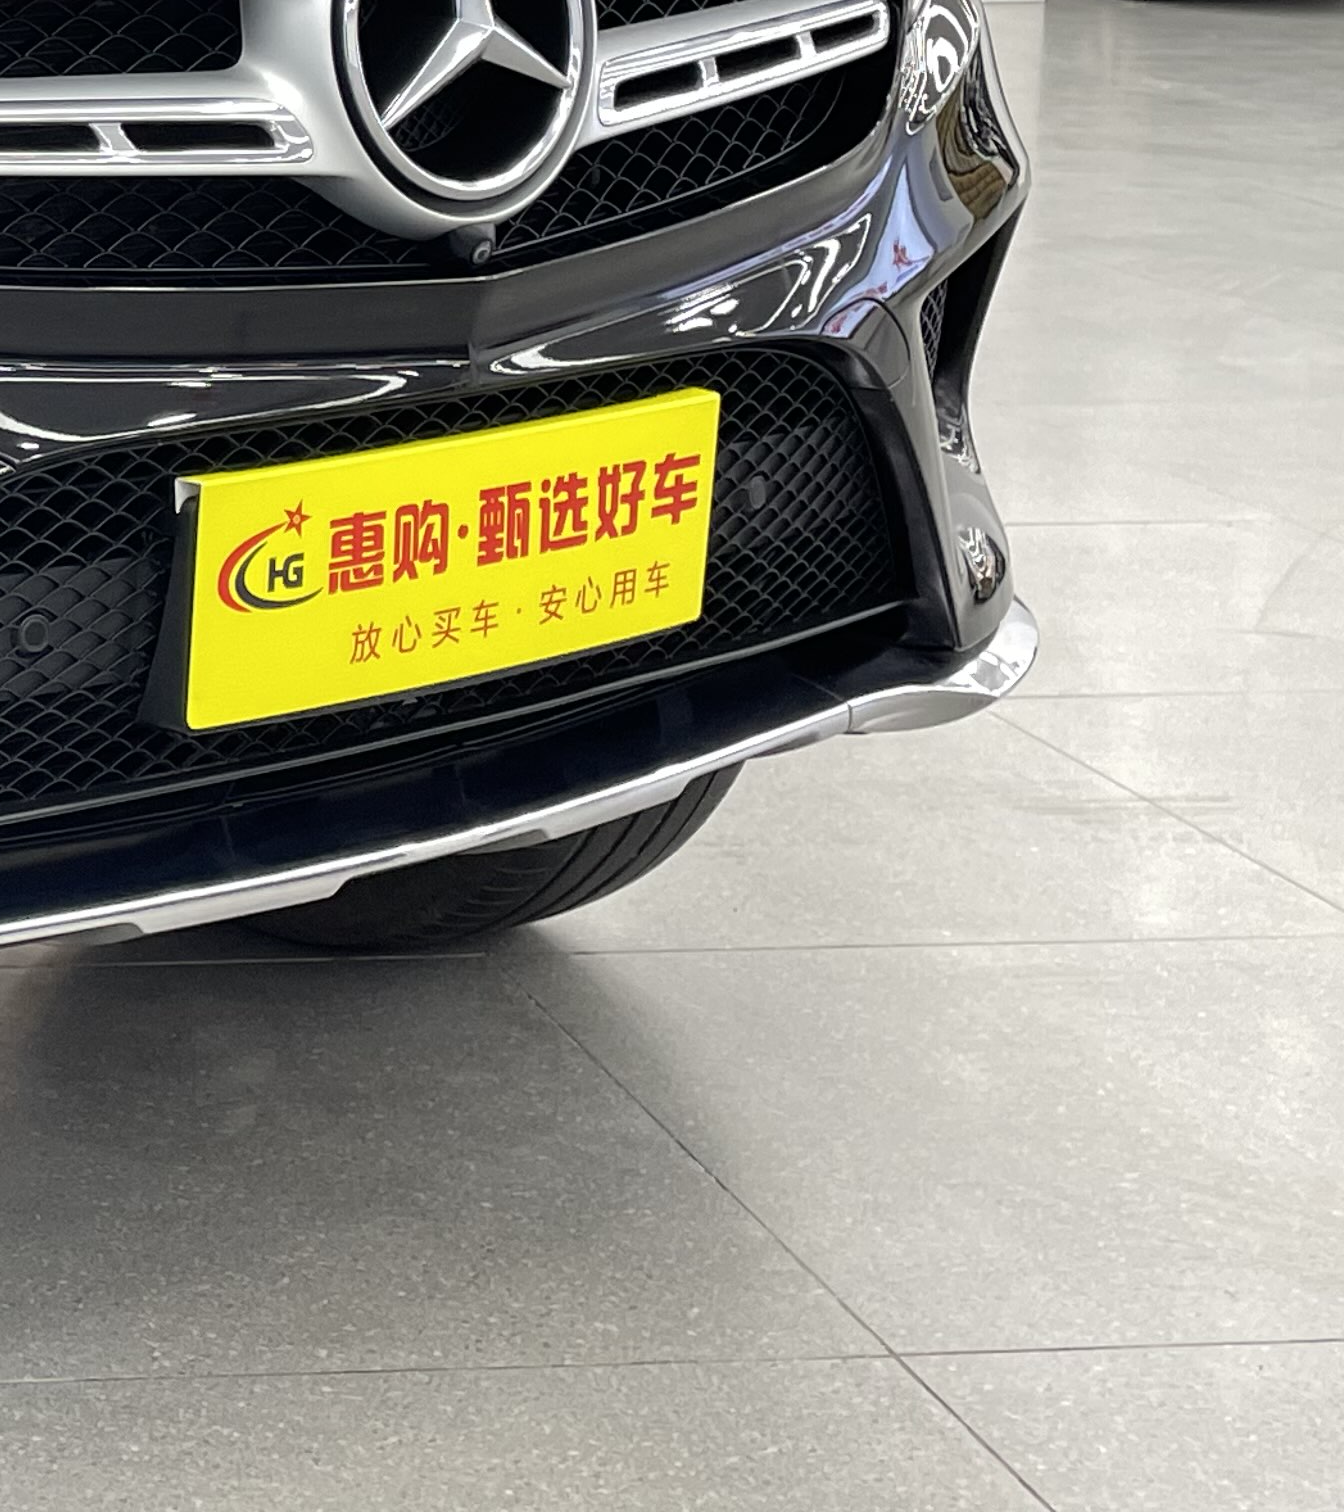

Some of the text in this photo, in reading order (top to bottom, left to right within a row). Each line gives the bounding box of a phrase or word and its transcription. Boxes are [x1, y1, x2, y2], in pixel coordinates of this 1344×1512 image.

[328, 452, 701, 595] 惠购·甄选好车
[267, 552, 304, 593] HG
